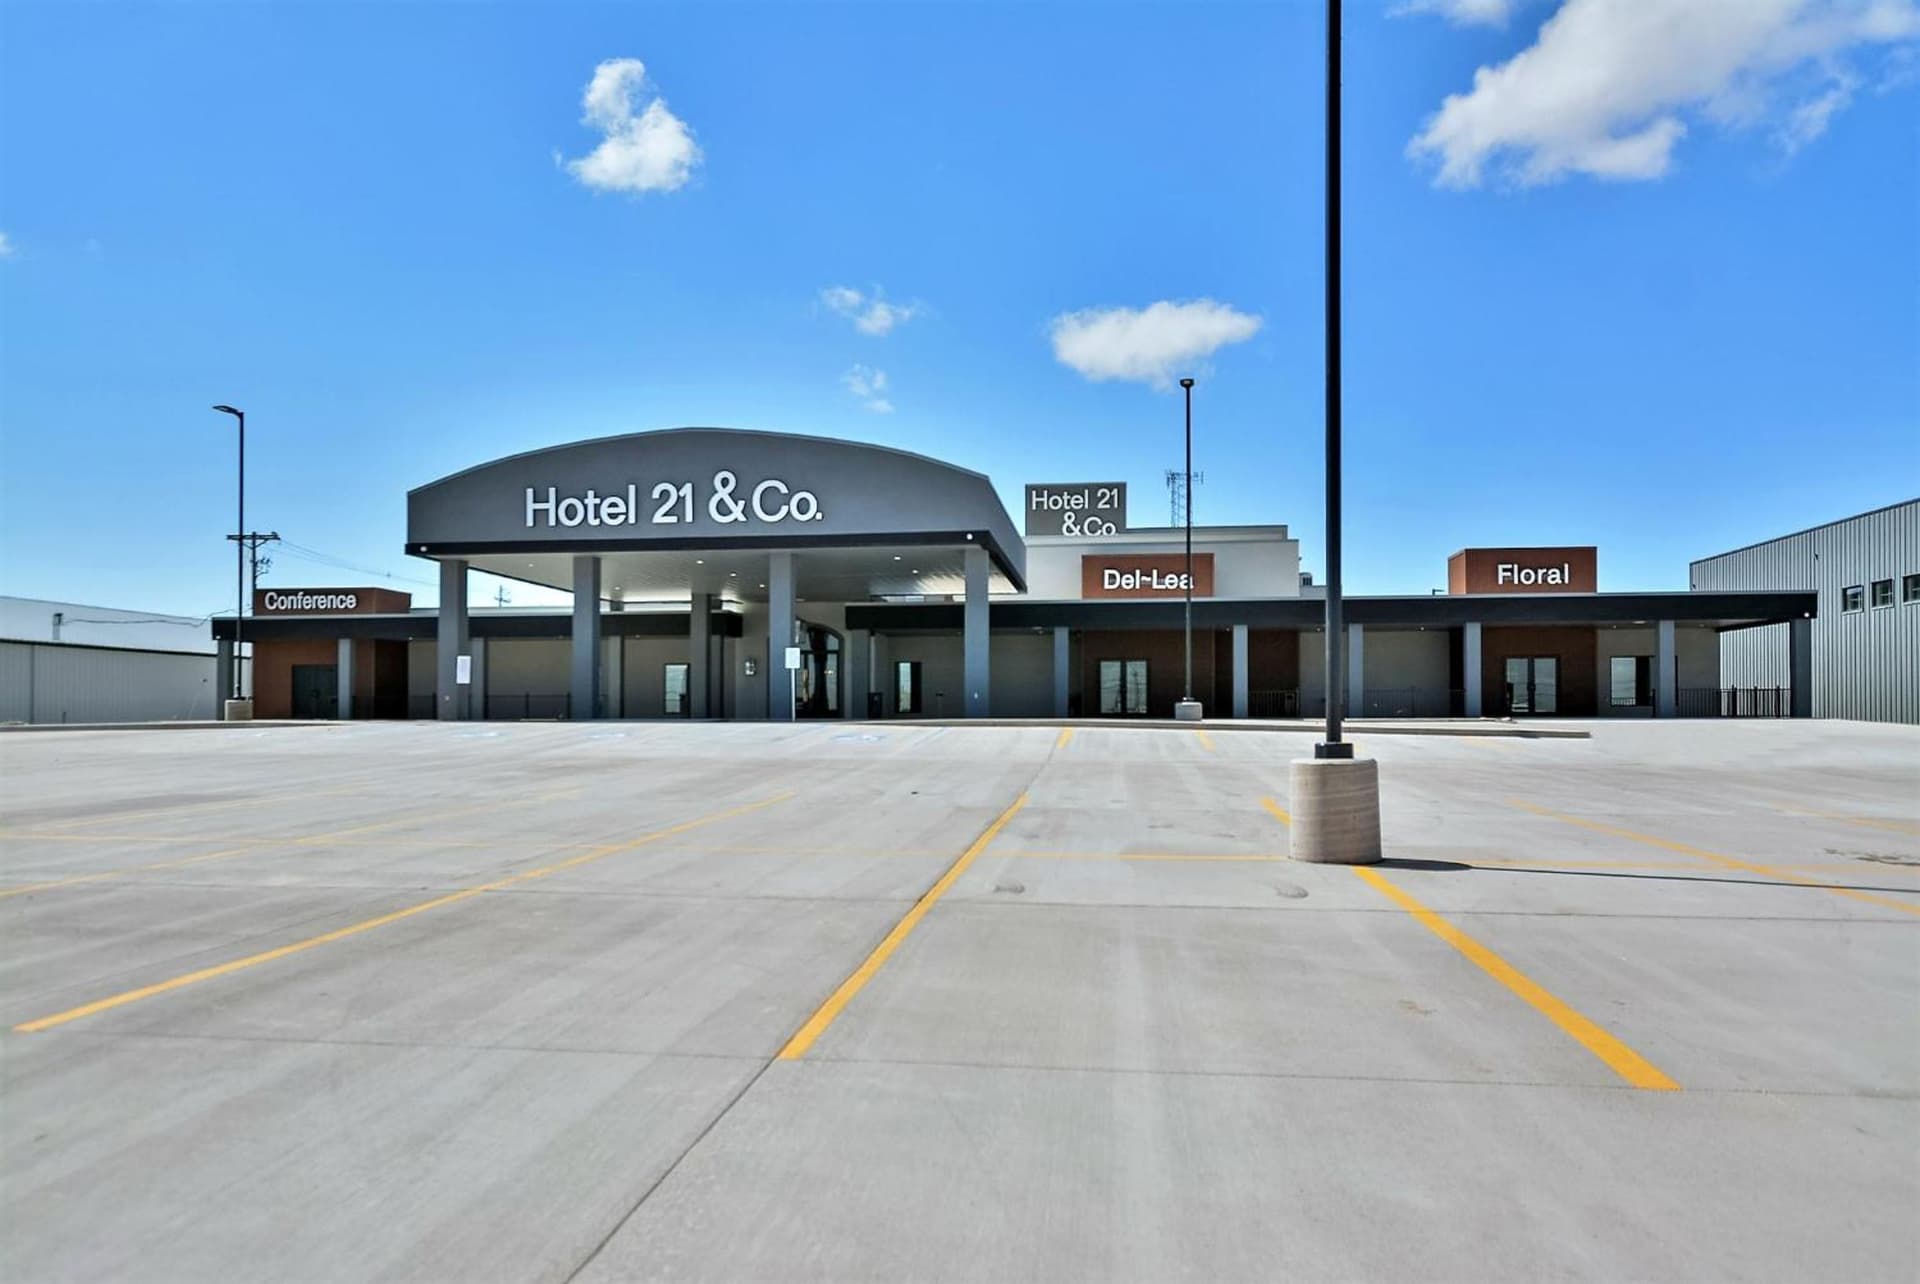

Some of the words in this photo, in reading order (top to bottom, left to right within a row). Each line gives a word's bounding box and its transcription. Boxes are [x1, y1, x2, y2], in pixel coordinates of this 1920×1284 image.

[525, 484, 636, 527] Hotel
[652, 482, 694, 523] 21
[1031, 488, 1089, 511] Hotel
[1096, 487, 1119, 509] 21
[1497, 562, 1570, 585] Floral
[264, 591, 357, 610] Conference
